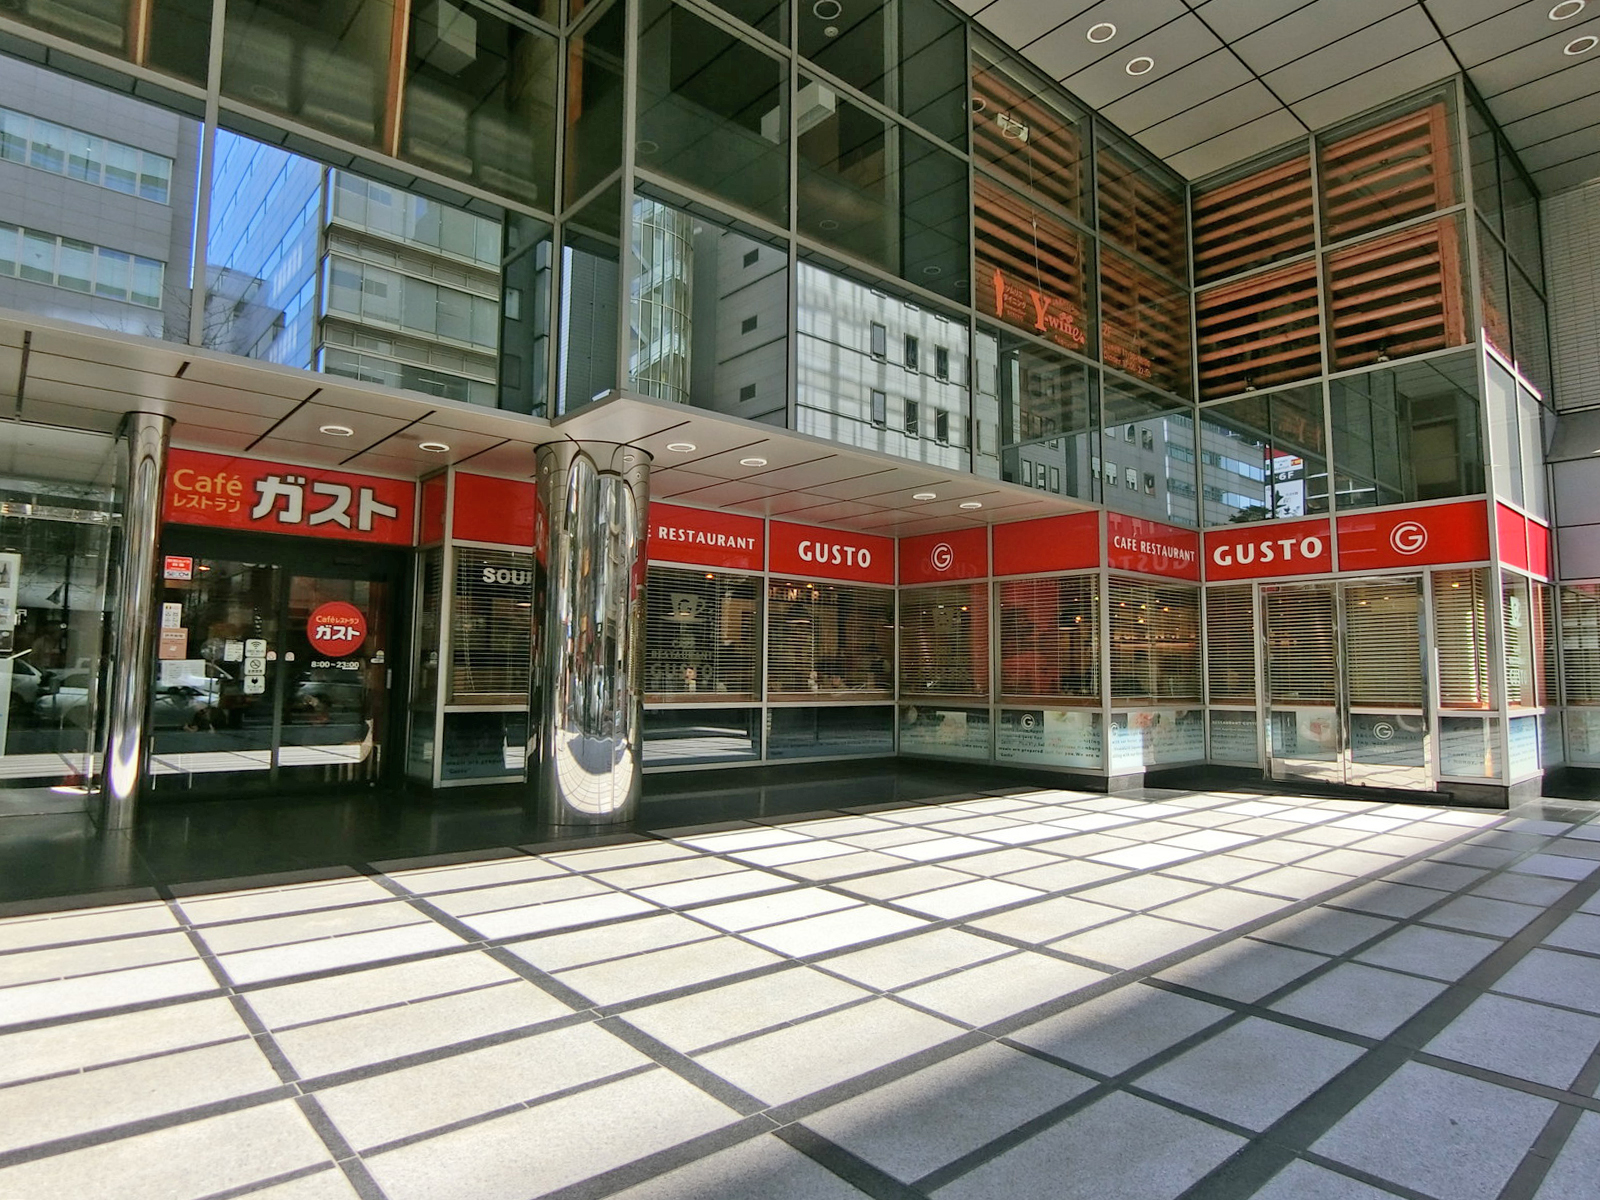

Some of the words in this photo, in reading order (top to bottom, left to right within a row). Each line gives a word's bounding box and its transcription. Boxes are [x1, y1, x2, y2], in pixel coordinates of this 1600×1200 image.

[173, 469, 243, 497] Café
[173, 493, 241, 512] レストラン
[252, 475, 397, 531] ガスト
[658, 526, 755, 550] RESTAURANT
[1114, 532, 1138, 551] CAFÉ
[1140, 541, 1195, 562] RESTAURANT
[1213, 536, 1323, 566] GUSTO
[1393, 524, 1425, 552] G
[798, 540, 871, 568] GUSTO
[933, 545, 951, 569] G
[315, 625, 360, 641] ガスト
